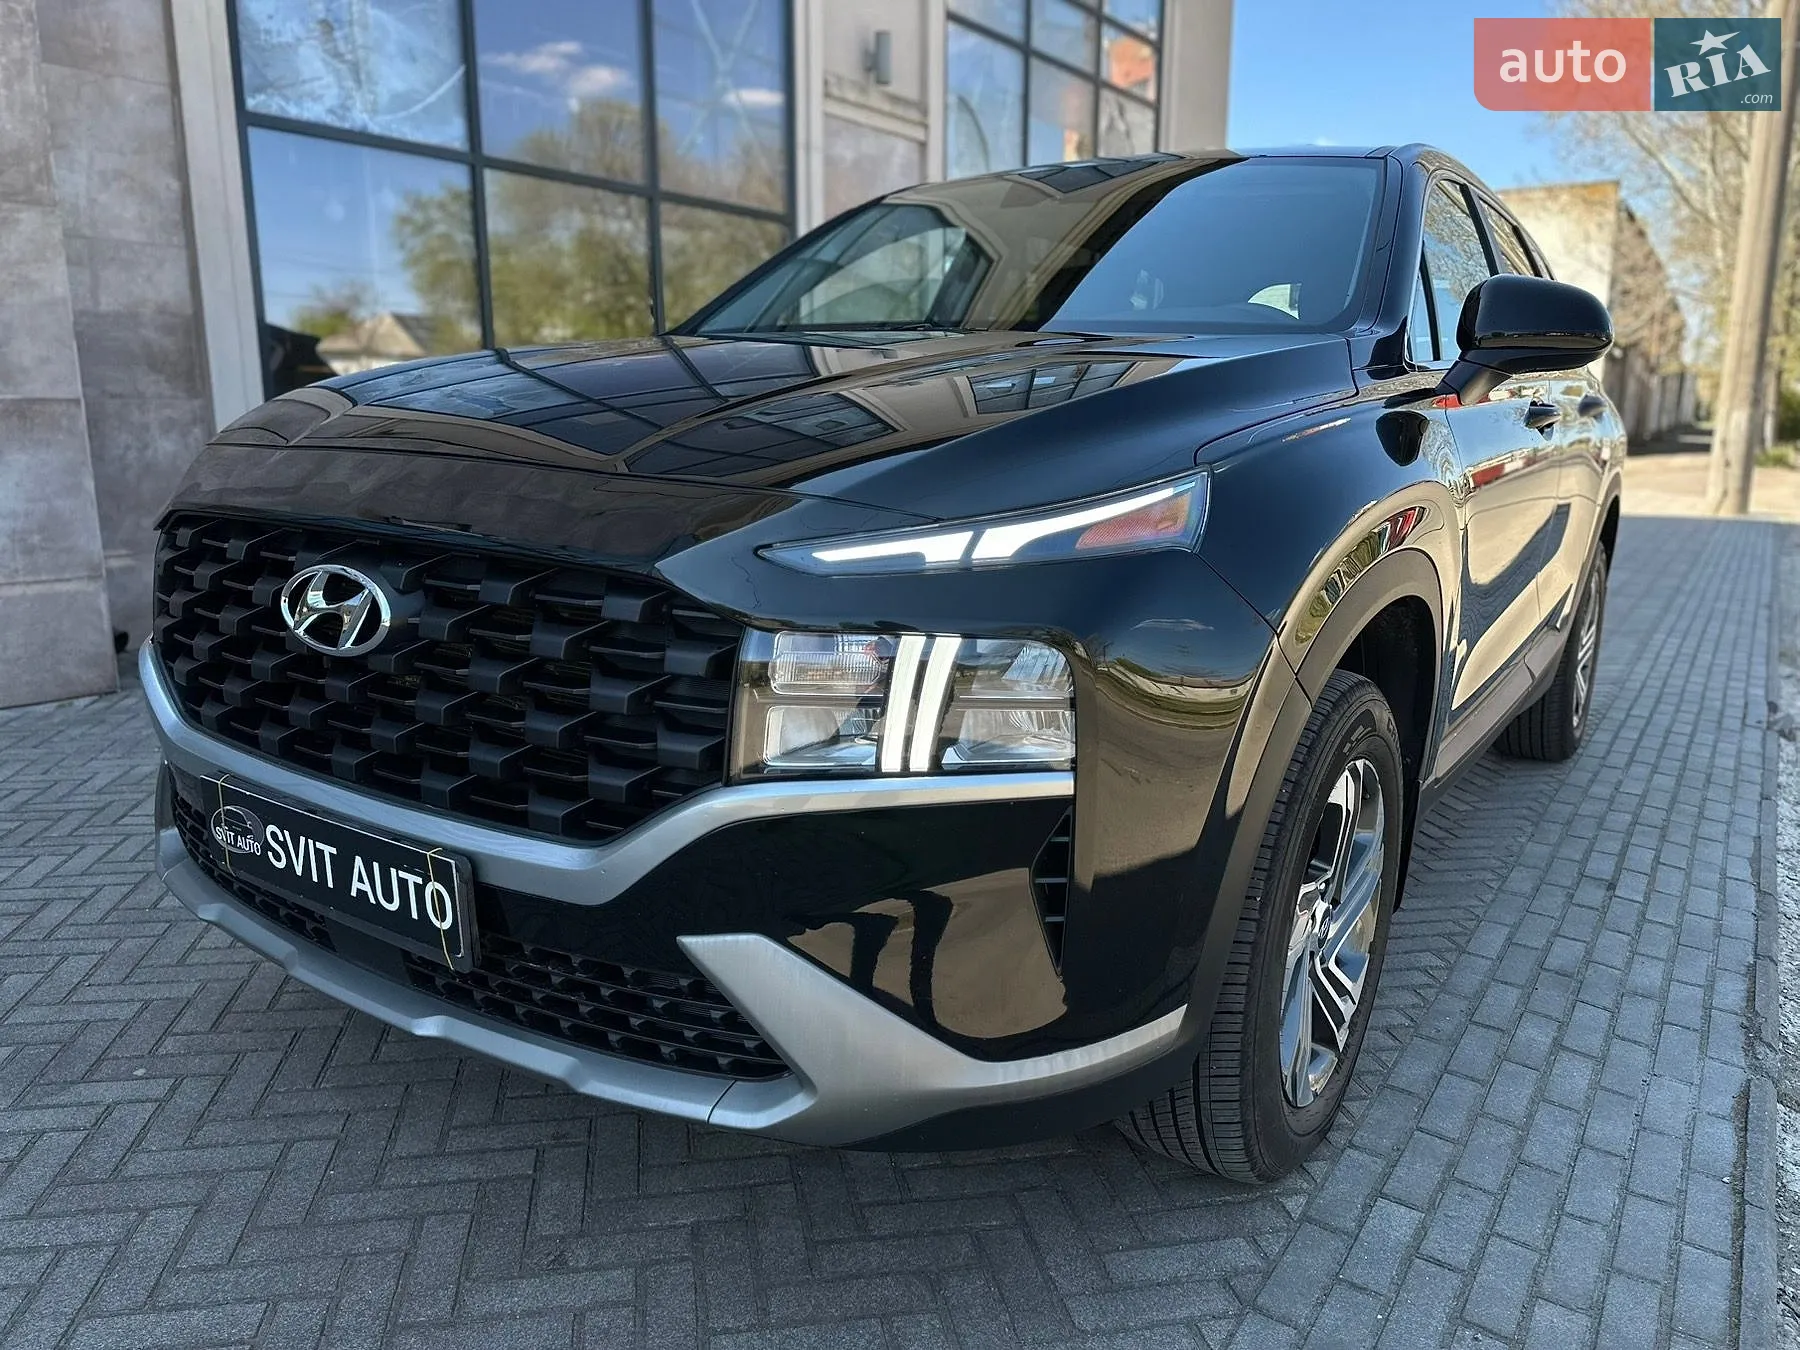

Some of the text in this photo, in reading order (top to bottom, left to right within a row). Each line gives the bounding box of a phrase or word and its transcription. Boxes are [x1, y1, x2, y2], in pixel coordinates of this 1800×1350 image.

[215, 826, 261, 856] SVIT AUTO
[265, 824, 453, 930] SVIT AUTO
